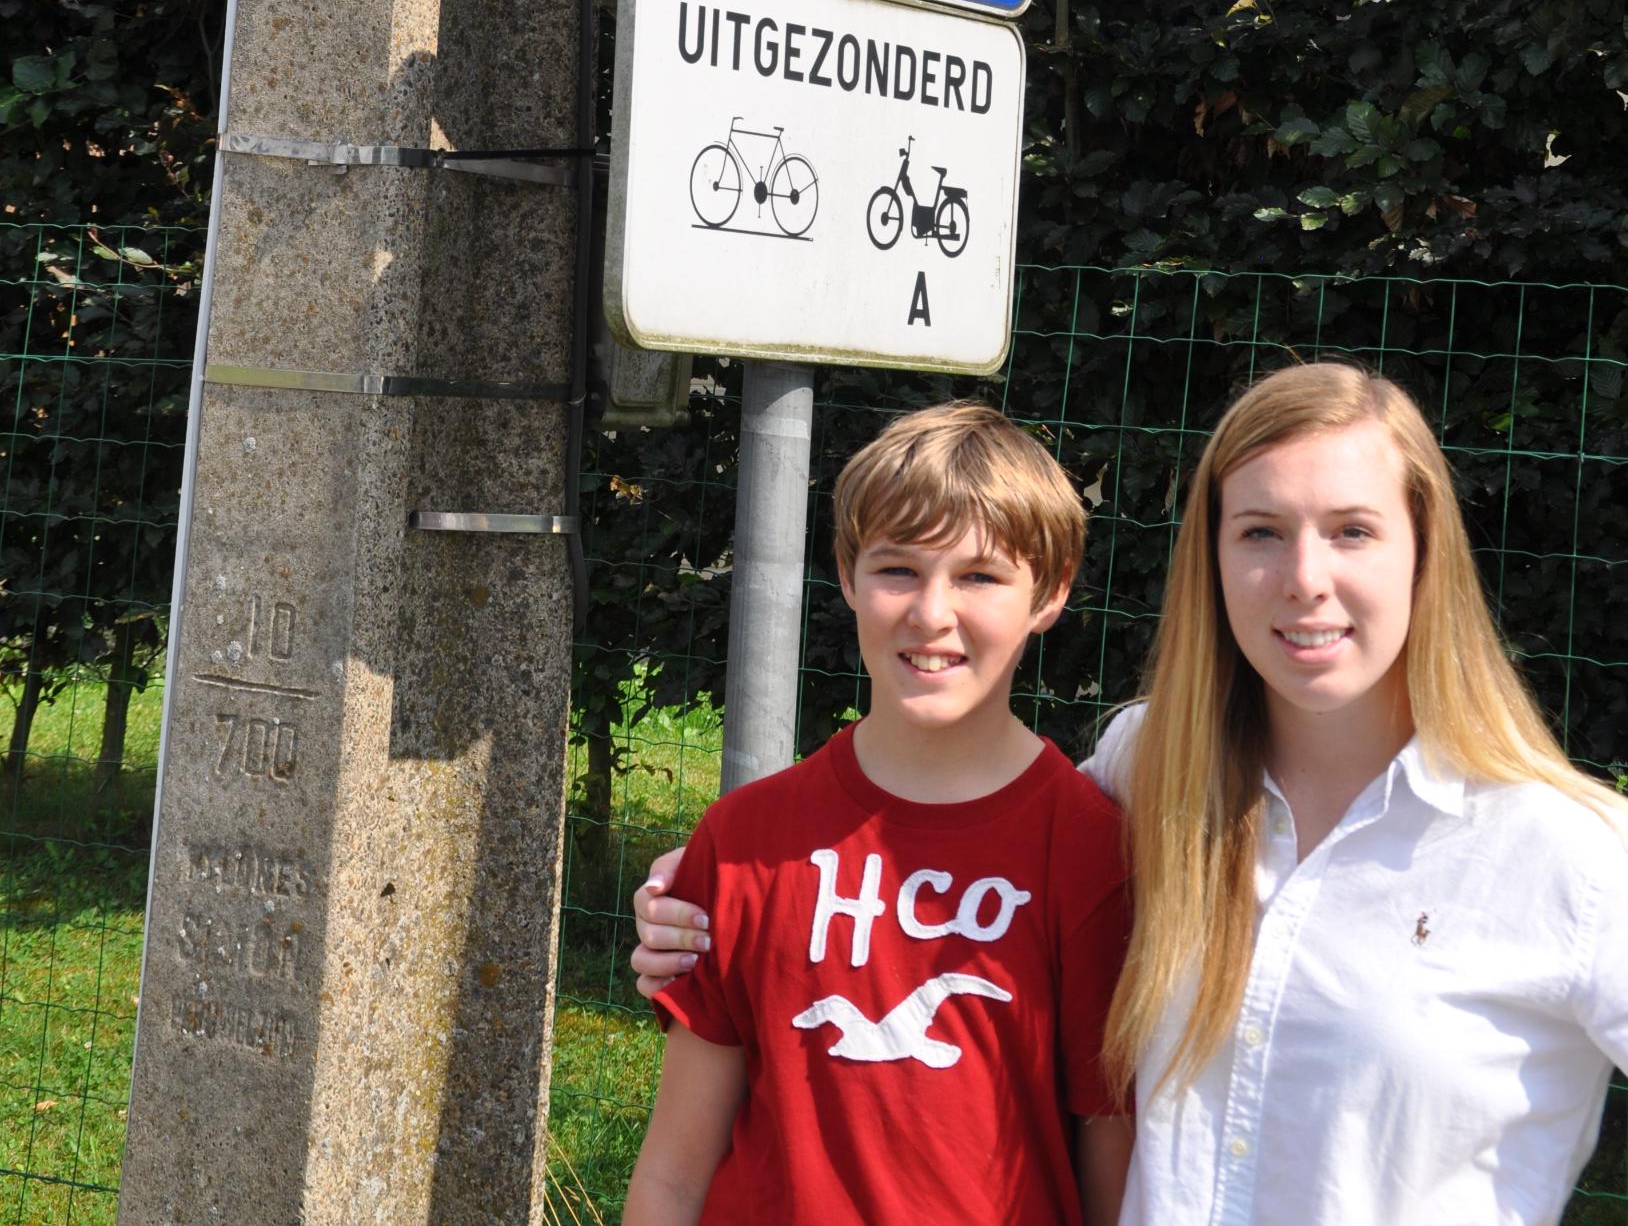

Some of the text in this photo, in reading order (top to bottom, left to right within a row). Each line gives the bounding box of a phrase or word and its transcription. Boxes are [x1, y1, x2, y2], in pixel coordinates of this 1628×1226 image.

[678, 1, 993, 115] UITGEZONDERD
[907, 271, 931, 327] A
[247, 594, 297, 662] 10
[214, 712, 299, 784] 700
